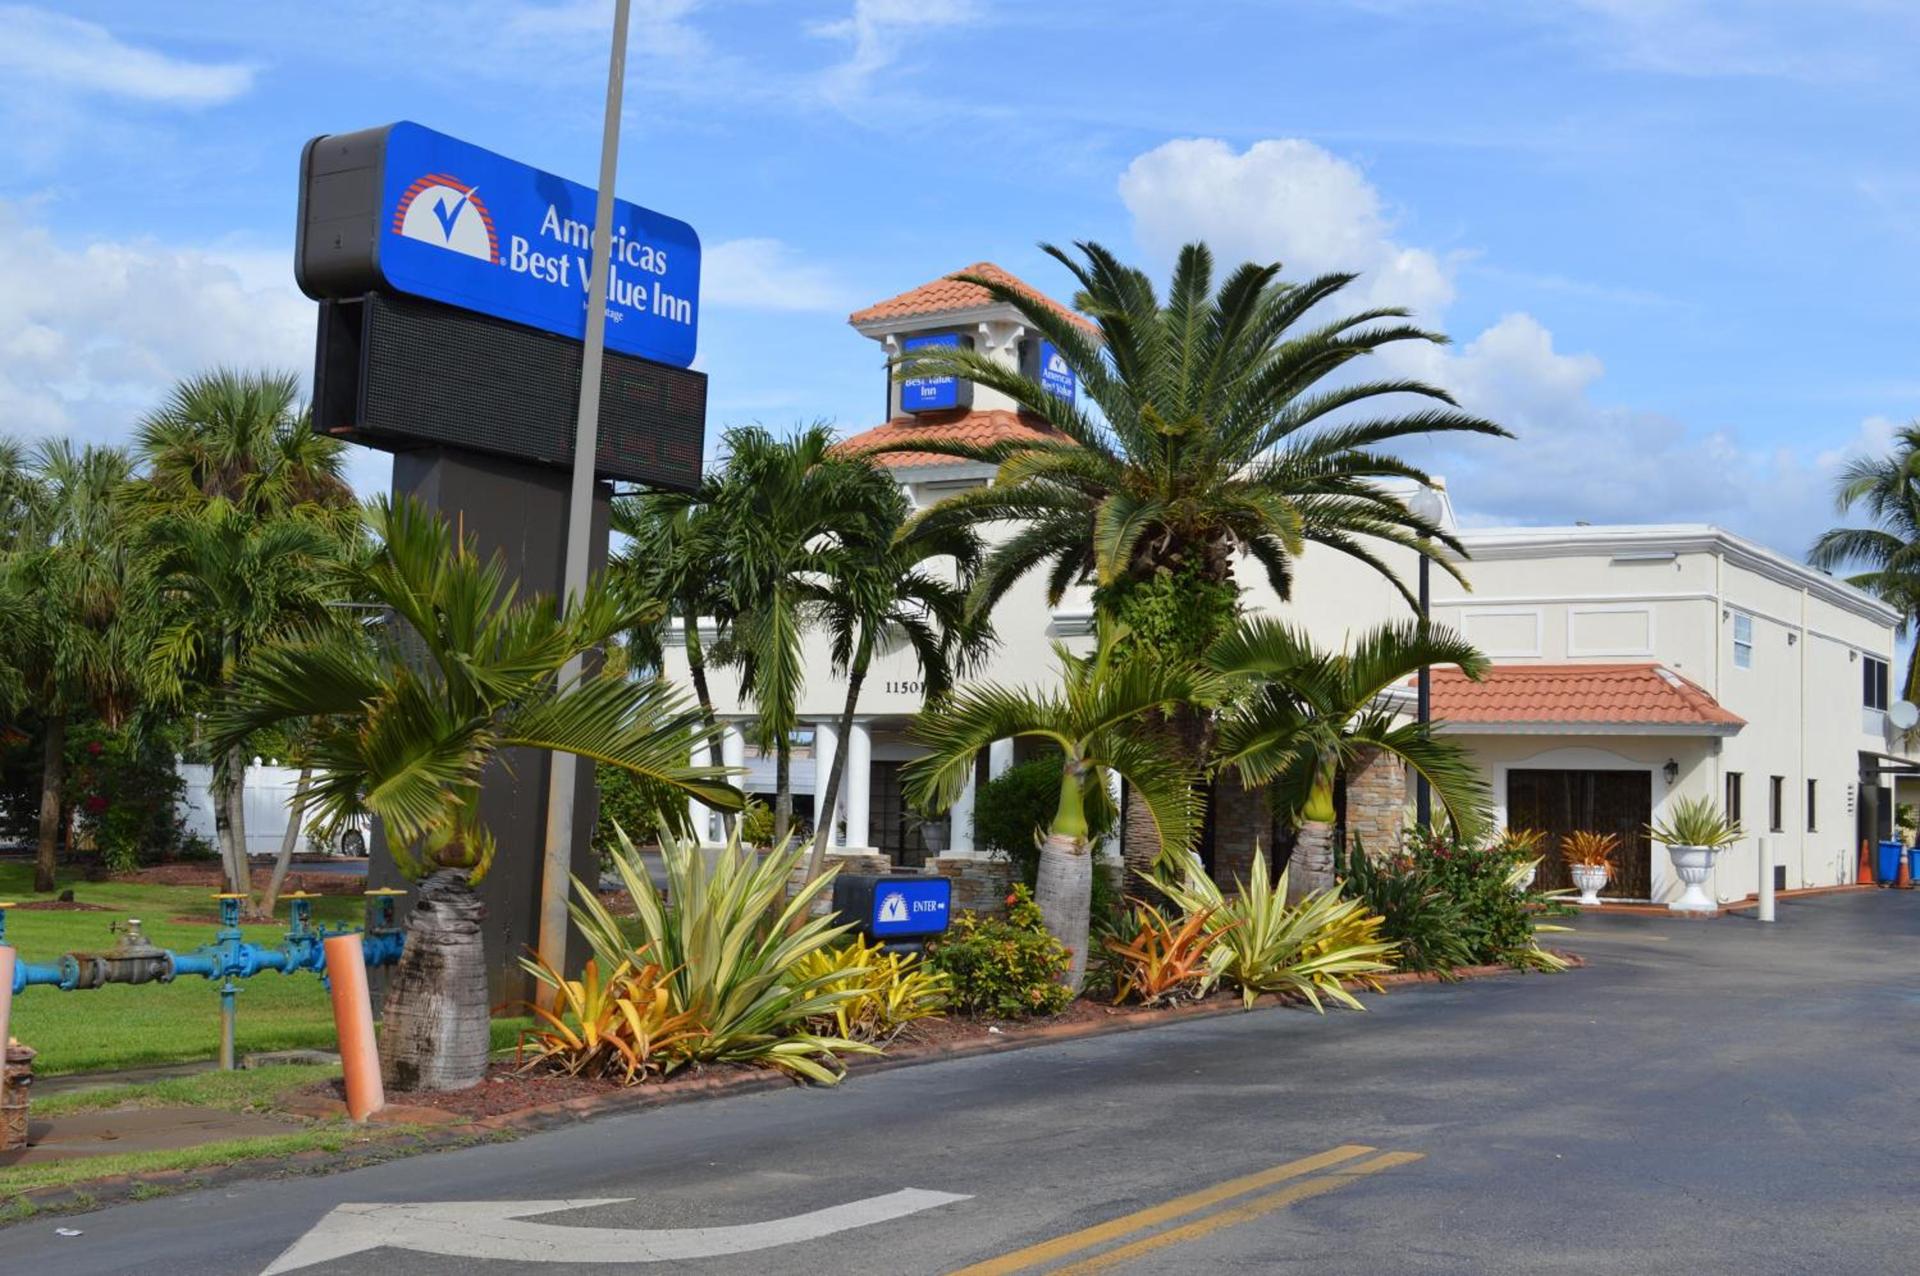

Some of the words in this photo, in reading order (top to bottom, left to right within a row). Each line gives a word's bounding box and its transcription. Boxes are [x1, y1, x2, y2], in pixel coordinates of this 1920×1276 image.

[510, 235, 570, 288] Best
[577, 256, 648, 311] Vlue
[652, 281, 691, 325] Inn
[920, 386, 937, 396] Inn
[913, 900, 937, 912] ENTER
